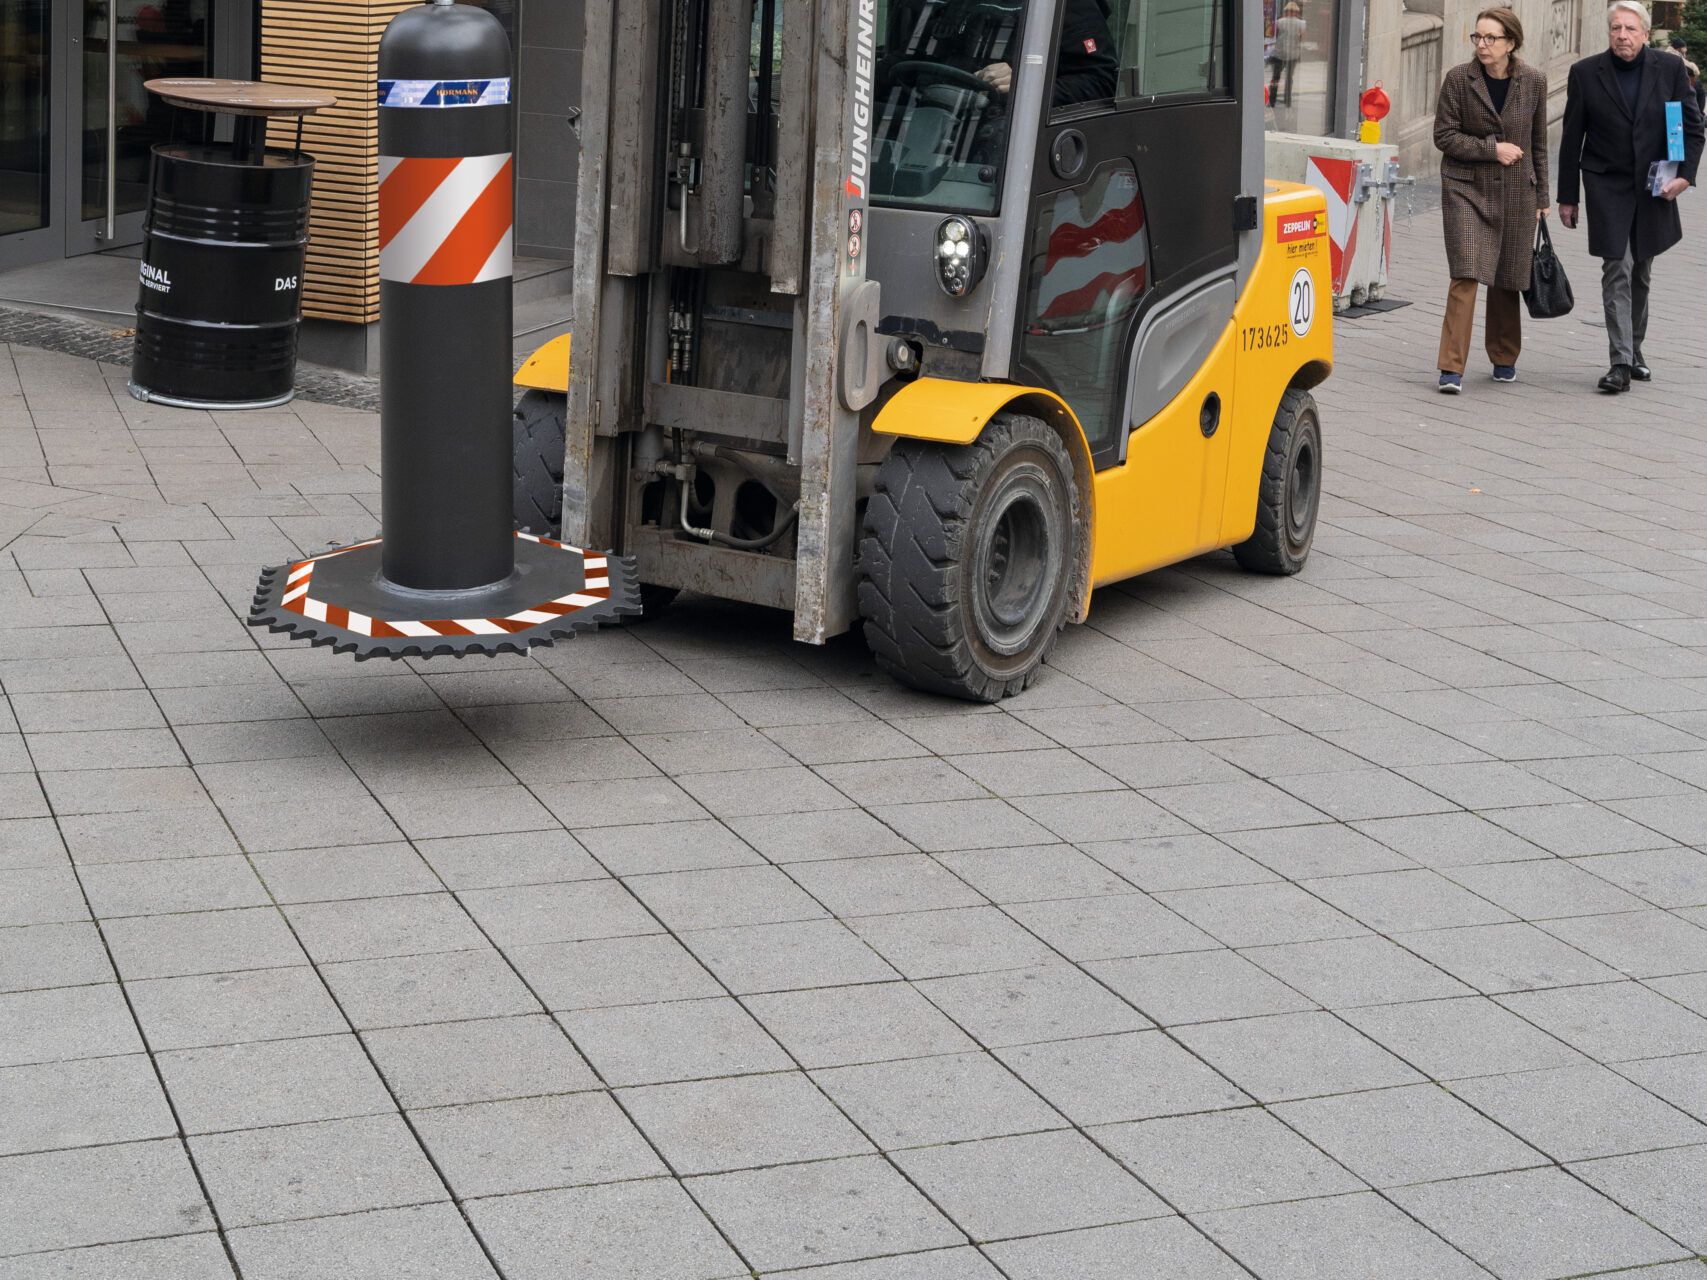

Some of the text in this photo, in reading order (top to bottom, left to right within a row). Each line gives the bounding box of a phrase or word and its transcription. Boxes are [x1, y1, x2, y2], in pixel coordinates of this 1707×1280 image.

[1283, 220, 1311, 234] ZEPPELIN
[274, 276, 297, 292] DAS
[1294, 280, 1310, 324] 20
[1242, 323, 1288, 351] 173625
